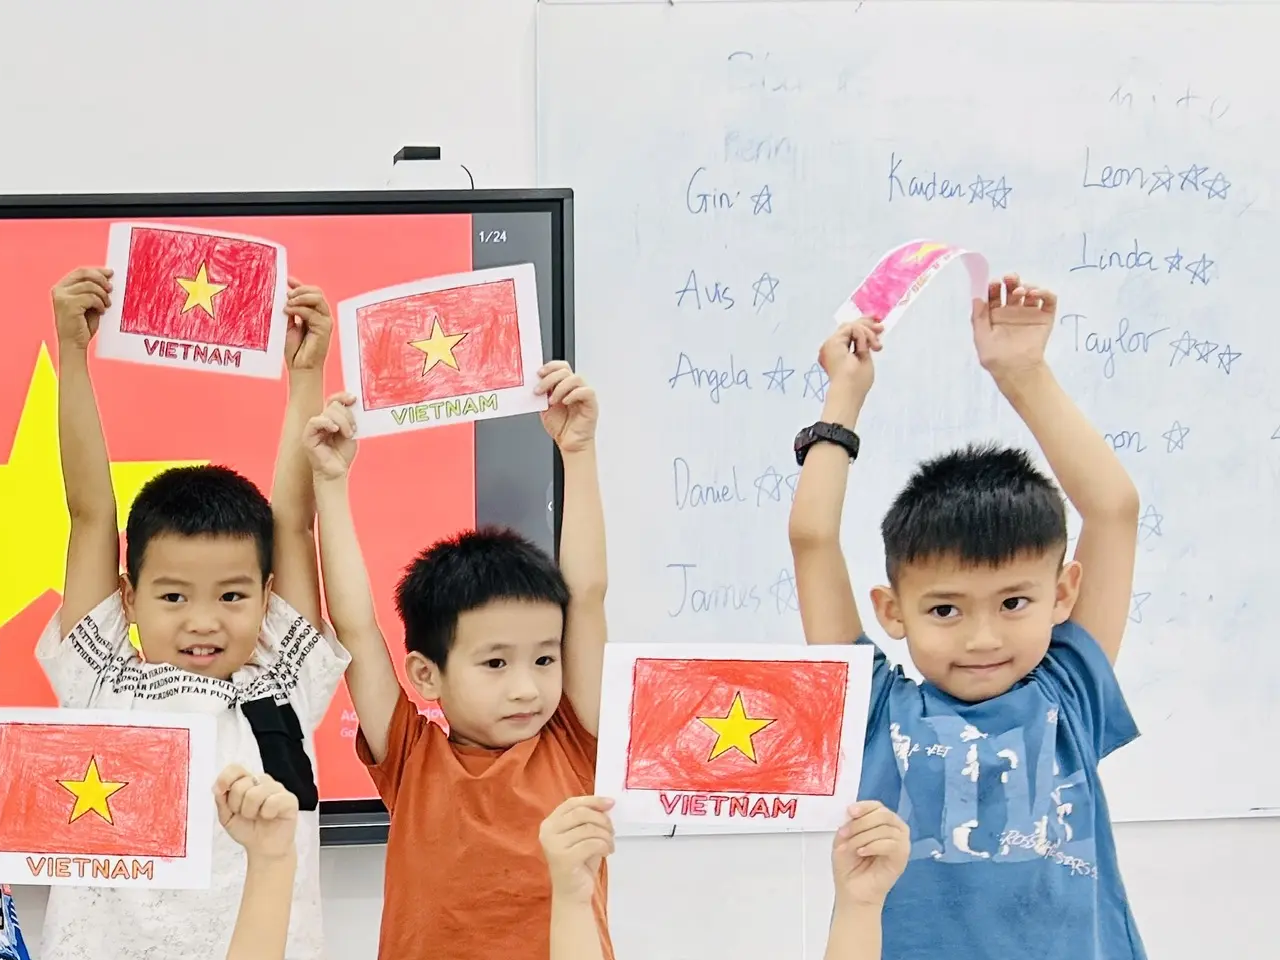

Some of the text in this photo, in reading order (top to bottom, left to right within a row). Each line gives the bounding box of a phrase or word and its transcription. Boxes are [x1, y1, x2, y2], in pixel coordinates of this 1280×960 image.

[887, 151, 967, 203] Kaiden
[1083, 145, 1150, 189] Leon
[479, 230, 507, 243] 1/24
[1069, 232, 1158, 272] Linda
[144, 339, 242, 368] VIETNAM
[1060, 313, 1170, 379] Taylor
[669, 352, 752, 403] Angela
[391, 393, 498, 425] VIETNAM
[673, 457, 747, 511] Daniel
[660, 792, 798, 819] VIETNAM
[26, 856, 154, 880] VIETNAM
